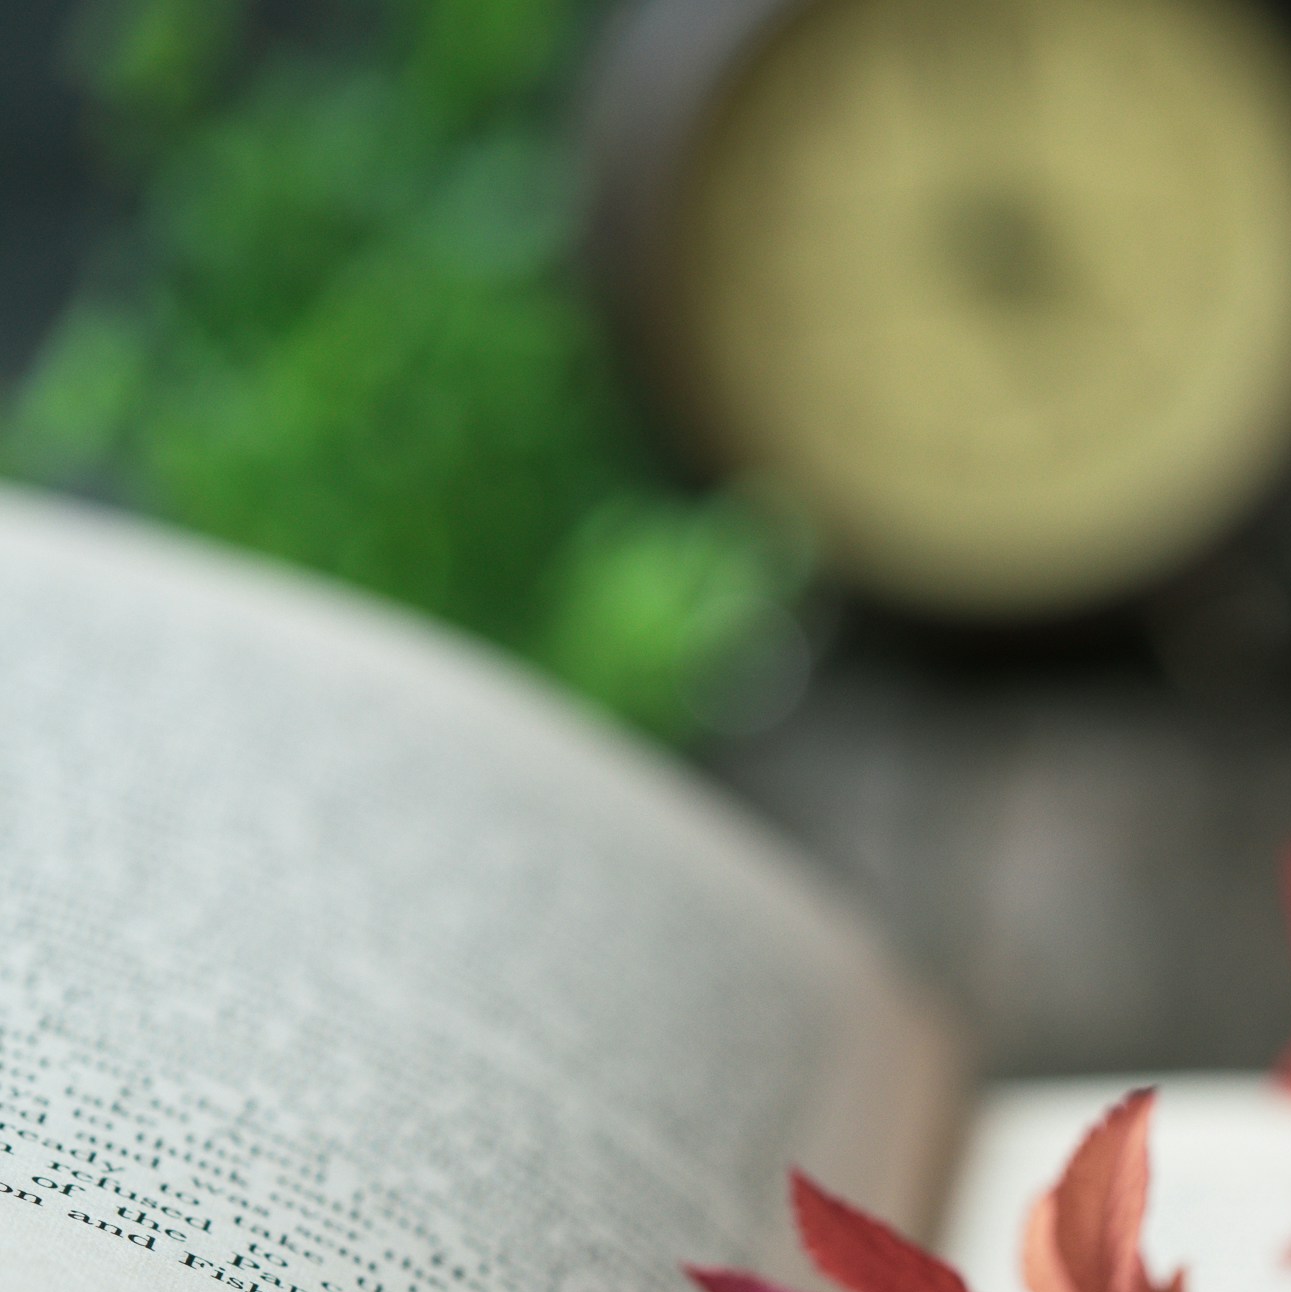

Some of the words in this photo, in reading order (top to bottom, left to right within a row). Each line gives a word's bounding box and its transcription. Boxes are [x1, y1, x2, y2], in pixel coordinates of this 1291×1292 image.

[31, 1175, 85, 1196] of
[116, 1206, 187, 1242] the
[48, 1161, 212, 1233] refused
[247, 1242, 288, 1268] to
[67, 1209, 156, 1252] and
[158, 1182, 200, 1206] to
[232, 1214, 323, 1263] take
